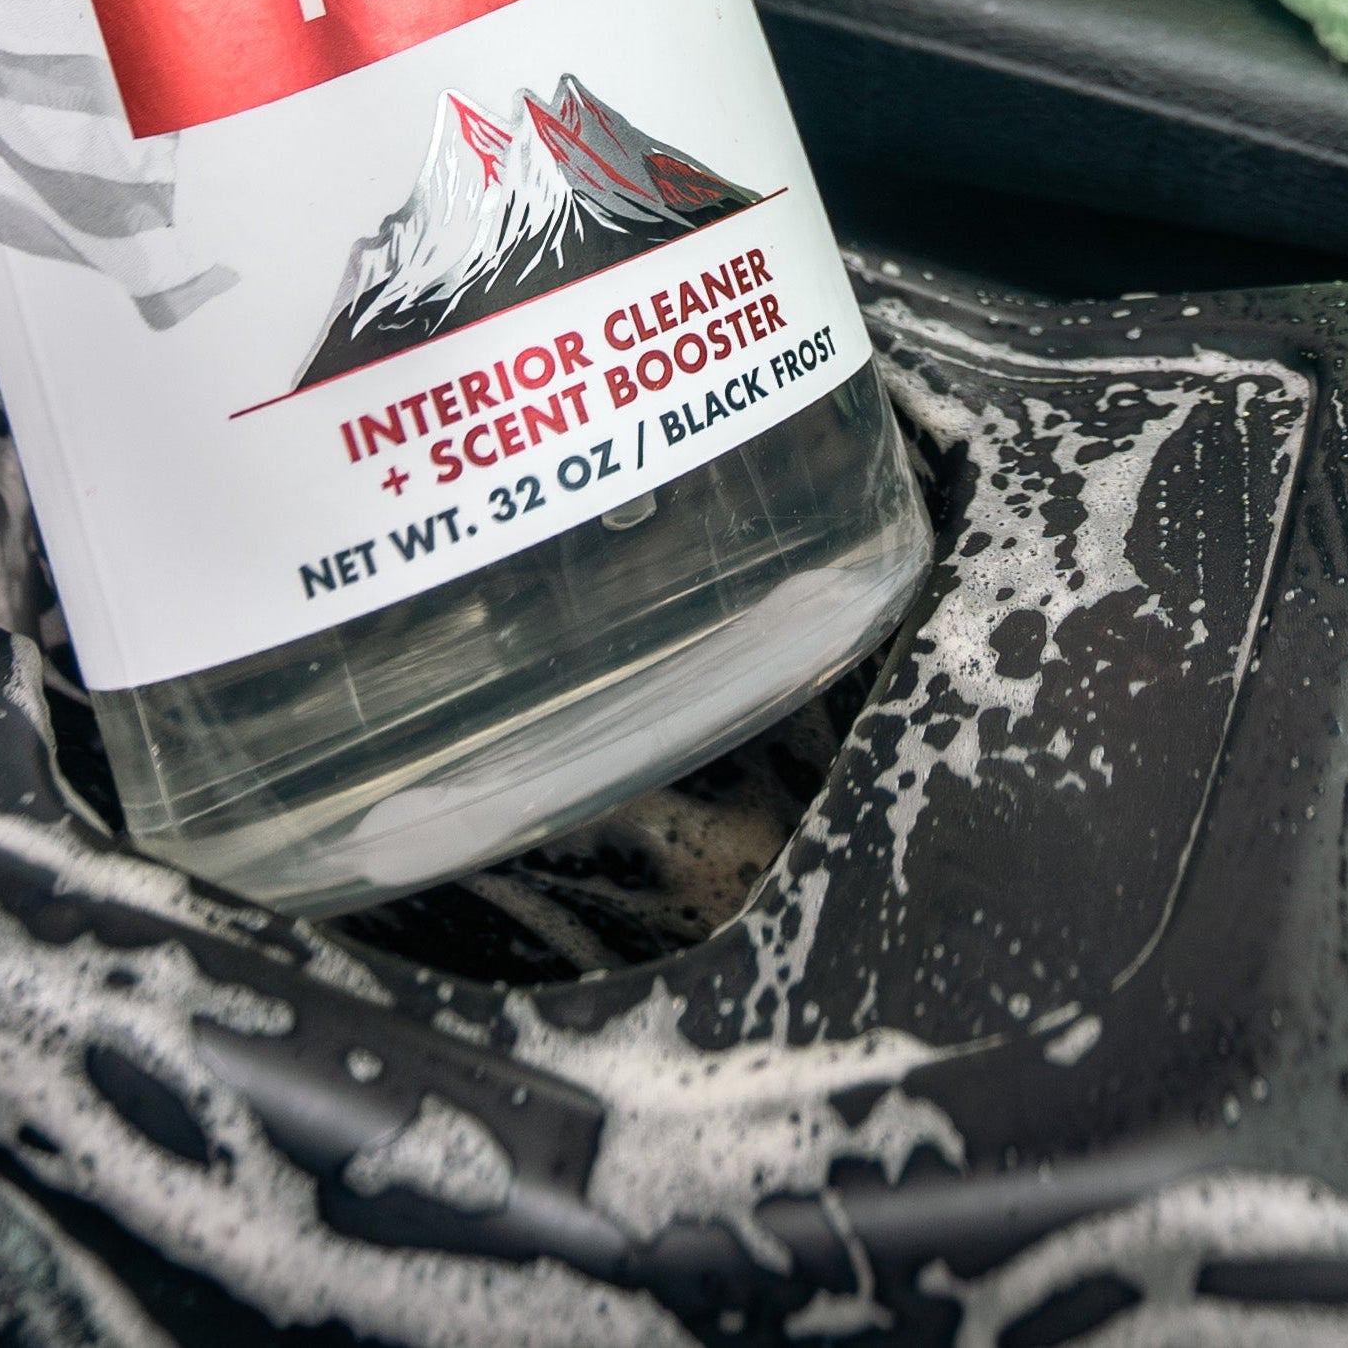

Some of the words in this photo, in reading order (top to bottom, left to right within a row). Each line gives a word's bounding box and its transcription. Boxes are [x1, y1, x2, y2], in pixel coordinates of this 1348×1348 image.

[299, 540, 377, 600] NET
[388, 506, 478, 563] WT.
[489, 474, 547, 523] 32
[557, 437, 621, 491] OZ
[634, 420, 646, 470] /
[659, 366, 769, 447] BLACK
[770, 326, 838, 387] FROST
[340, 331, 594, 464] INTERIOR
[604, 248, 773, 351] CLEANER
[382, 466, 410, 497] +
[430, 381, 591, 484] SCENT
[603, 293, 788, 410] BOOSTER
